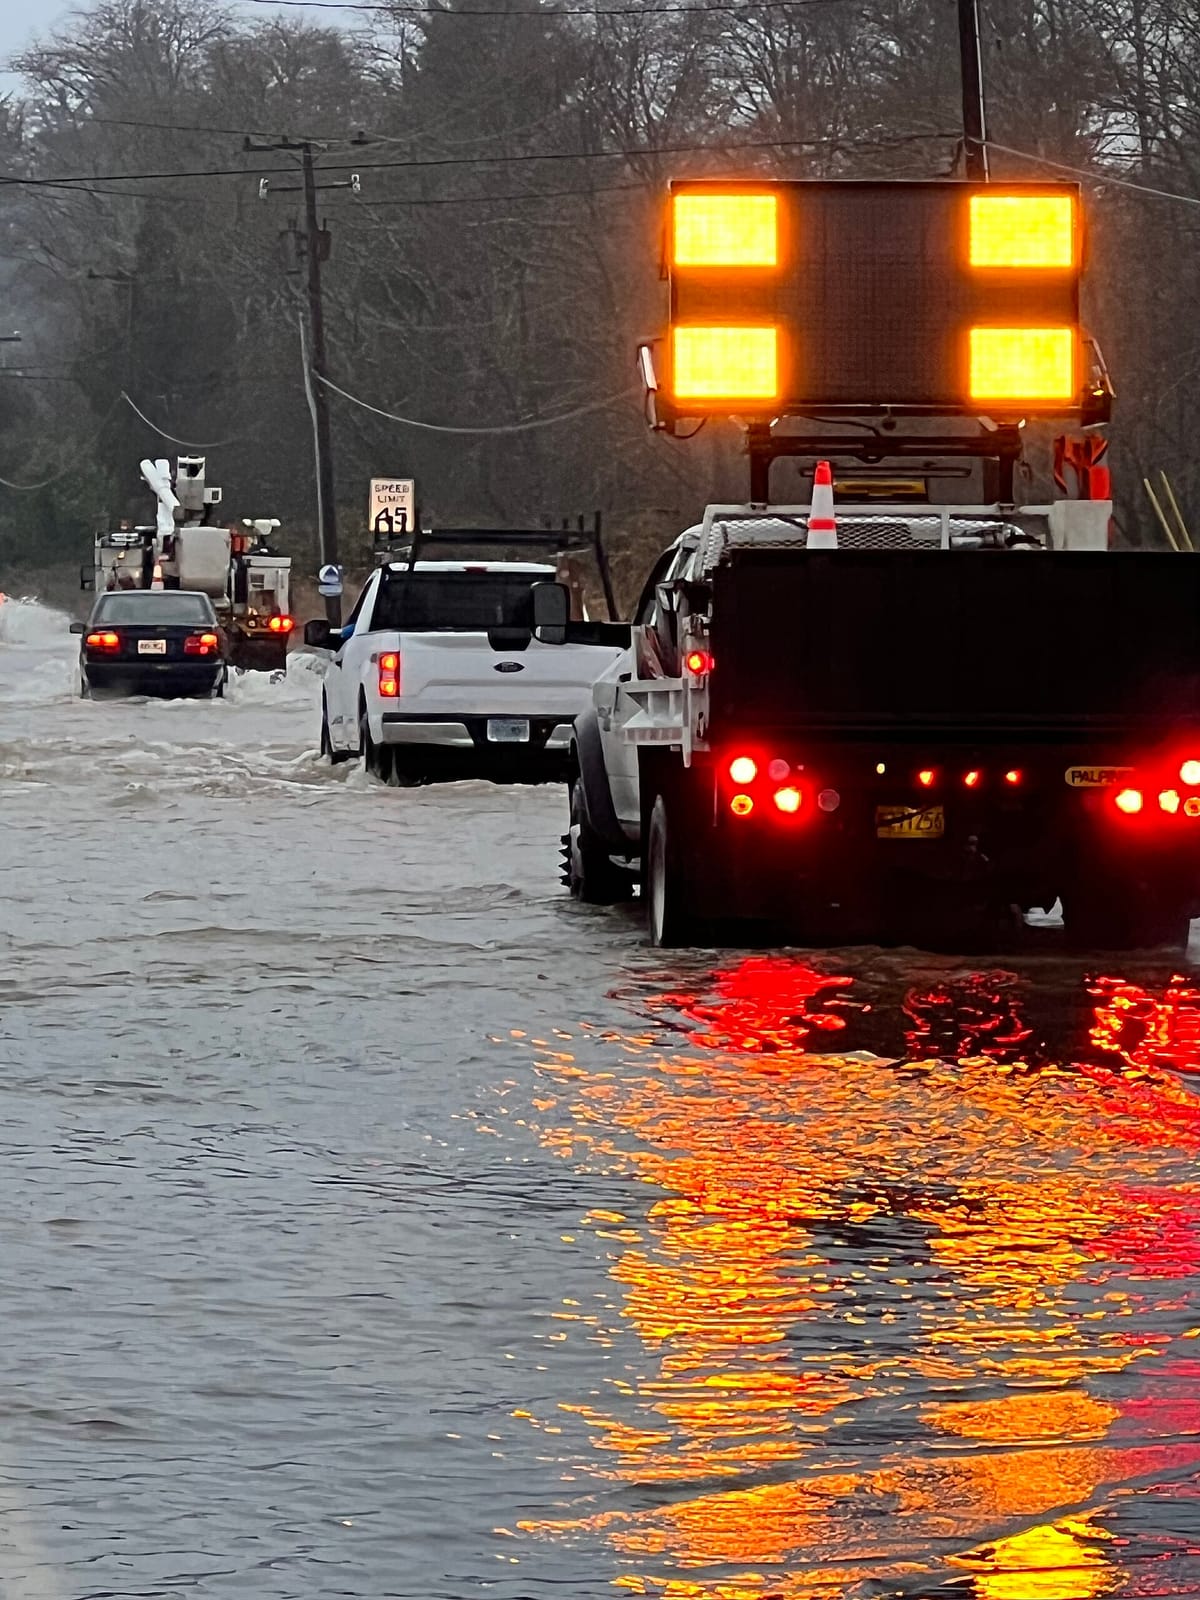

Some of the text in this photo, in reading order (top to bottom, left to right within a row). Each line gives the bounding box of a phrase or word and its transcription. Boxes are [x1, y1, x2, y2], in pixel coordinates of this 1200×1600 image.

[375, 484, 409, 494] SPEED
[377, 495, 405, 503] LIMIT
[375, 507, 407, 529] 45
